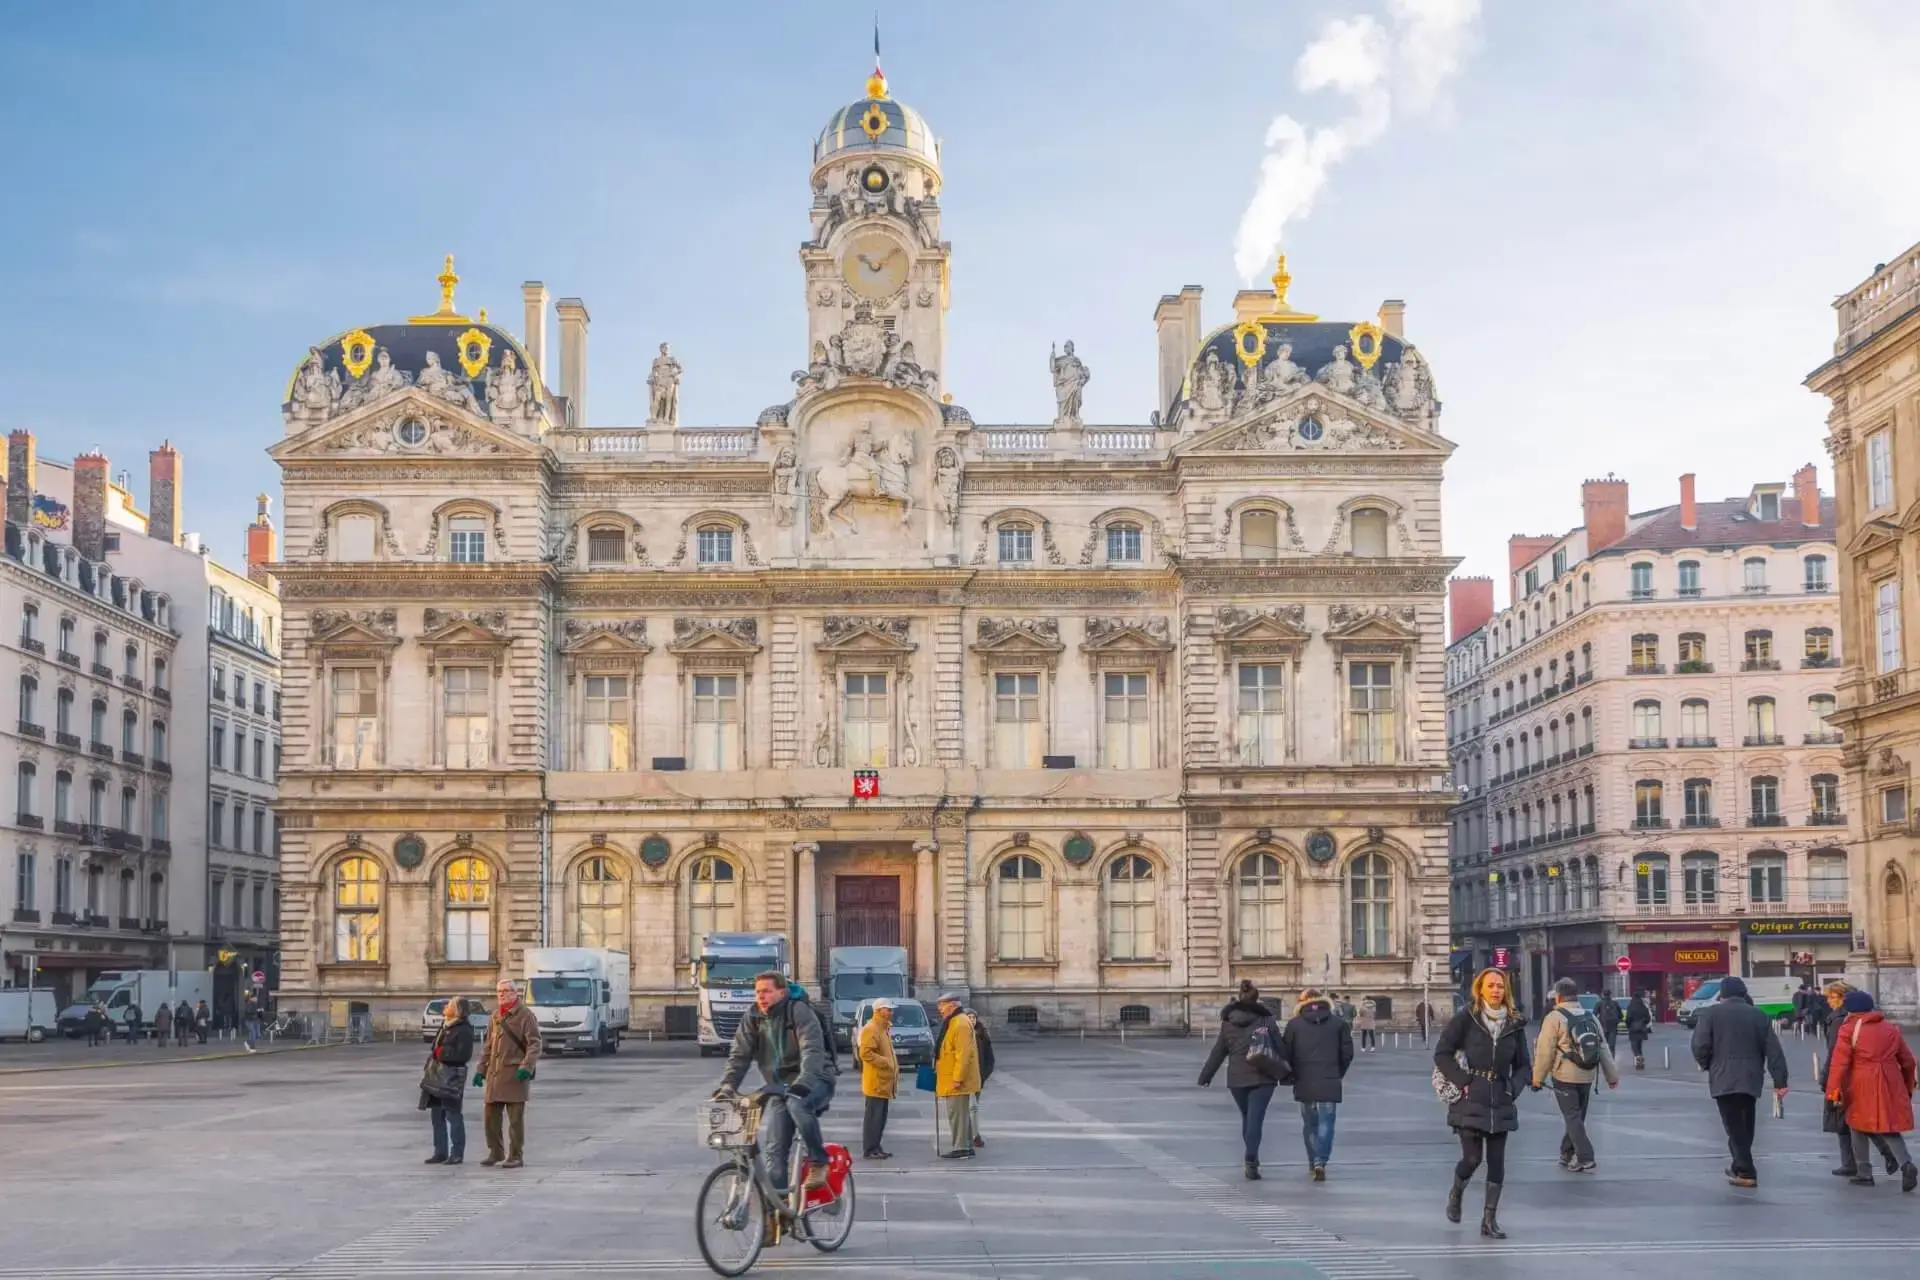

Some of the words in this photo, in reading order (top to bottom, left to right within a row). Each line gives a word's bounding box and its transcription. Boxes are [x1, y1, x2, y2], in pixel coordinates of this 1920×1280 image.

[1751, 921, 1794, 934] Optique
[1799, 920, 1849, 930] Terreaux
[1677, 952, 1716, 960] NICOLAS
